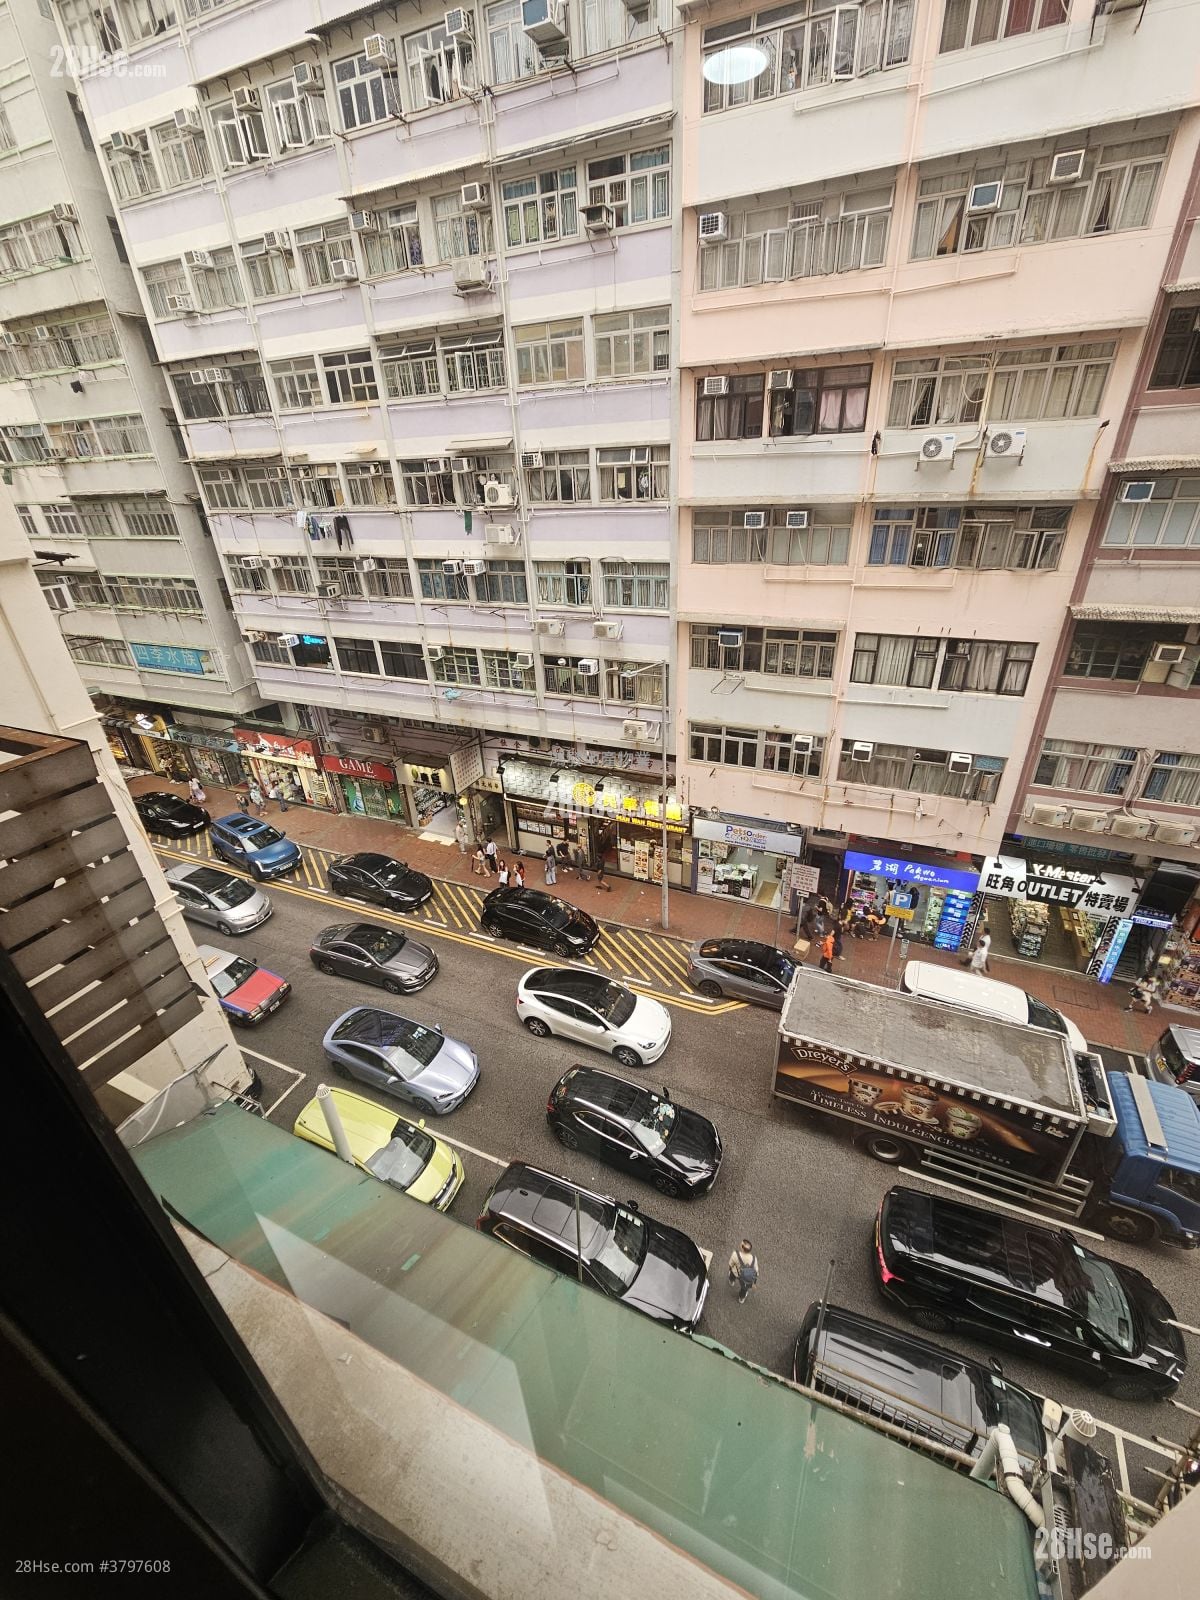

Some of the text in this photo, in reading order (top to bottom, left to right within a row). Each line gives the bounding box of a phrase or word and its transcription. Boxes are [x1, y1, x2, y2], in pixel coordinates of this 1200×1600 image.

[134, 644, 198, 667] 四季水族
[338, 757, 374, 774] GAME
[646, 819, 688, 834] RESTURANT
[894, 894, 908, 906] P
[985, 873, 1130, 913] 旺角 OUTLET 特賣場
[811, 1093, 955, 1147] TIMELESS INDULGENCE
